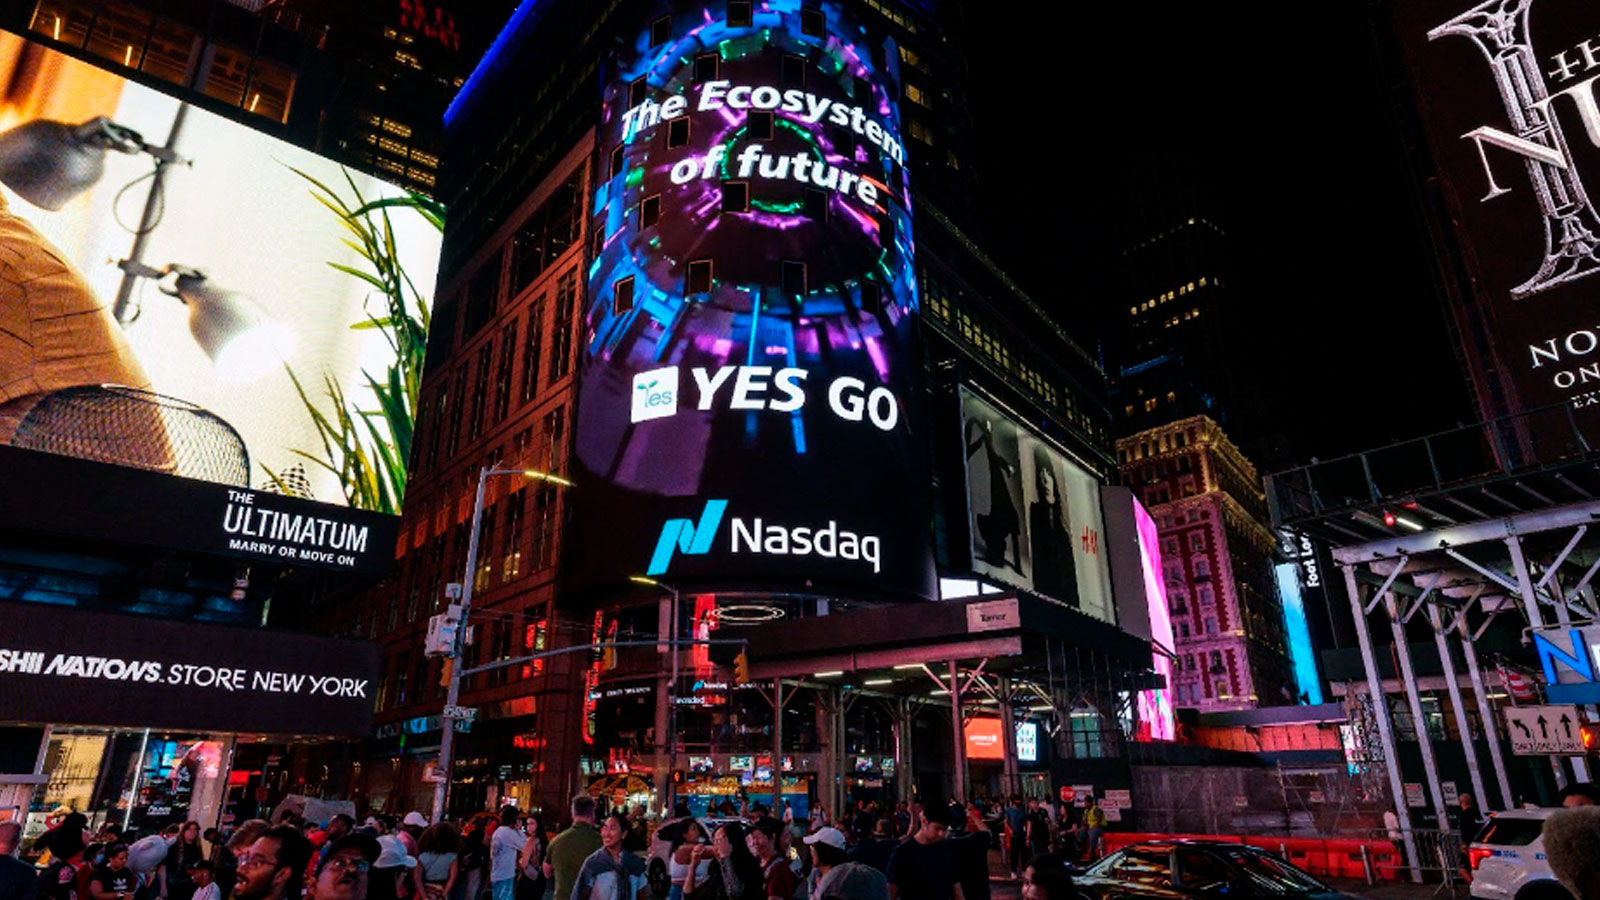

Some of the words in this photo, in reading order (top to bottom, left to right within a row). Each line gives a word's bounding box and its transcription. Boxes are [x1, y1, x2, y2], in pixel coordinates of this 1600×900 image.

[621, 93, 688, 145] The
[697, 79, 904, 167] Ecosystem
[670, 144, 728, 185] of
[737, 144, 879, 206] future
[692, 365, 809, 412] YES
[228, 490, 255, 505] THE
[223, 503, 369, 553] ULTIMATUM
[731, 518, 881, 573] Nasdaq
[229, 539, 276, 555] MARRY
[278, 546, 297, 558] OR
[300, 549, 335, 563] MOVE
[337, 554, 356, 567] ON
[1303, 559, 1320, 587] Foot
[167, 663, 247, 692] STORE
[252, 670, 306, 694] NEW
[309, 674, 368, 699] YORK
